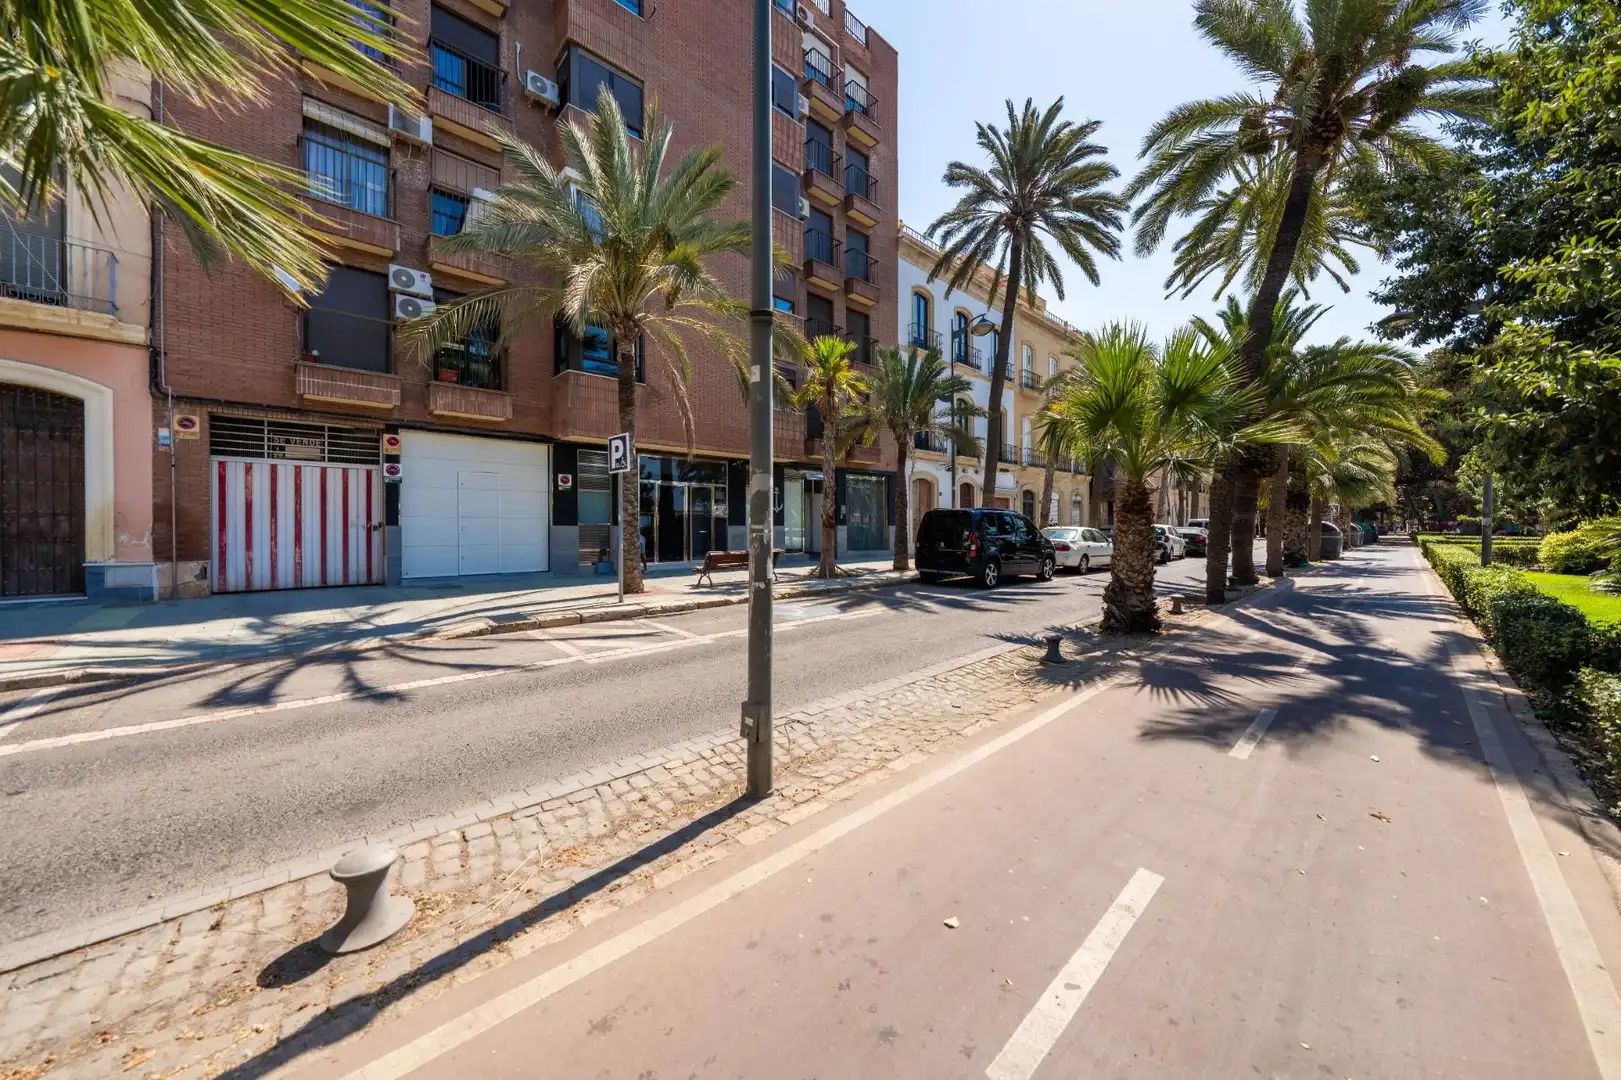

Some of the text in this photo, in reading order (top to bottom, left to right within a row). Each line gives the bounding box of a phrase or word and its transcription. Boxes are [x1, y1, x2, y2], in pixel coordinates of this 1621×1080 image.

[274, 436, 321, 448] SE VENDE
[611, 439, 624, 469] P
